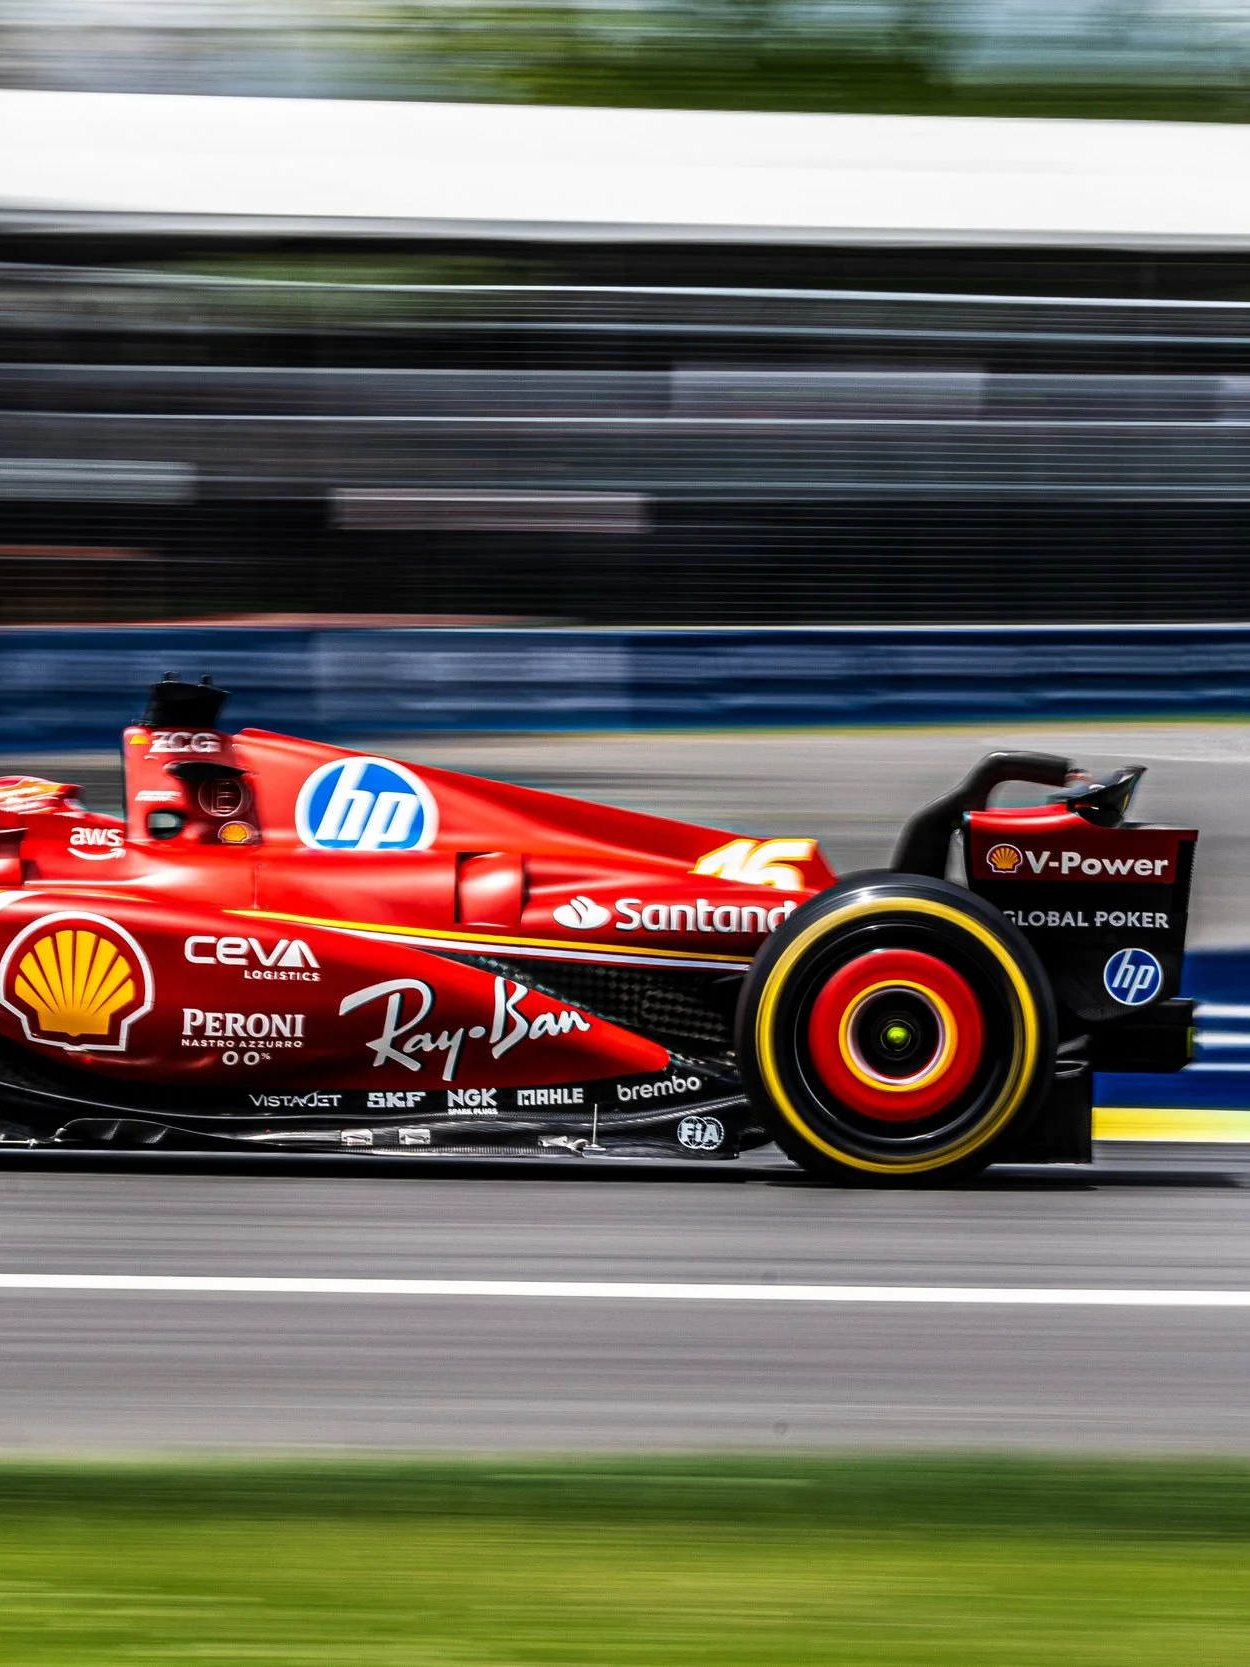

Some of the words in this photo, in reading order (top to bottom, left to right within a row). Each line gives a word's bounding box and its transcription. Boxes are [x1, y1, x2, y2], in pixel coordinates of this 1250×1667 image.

[312, 762, 421, 850] hp
[70, 827, 125, 847] aws
[1025, 851, 1169, 876] V-Power
[615, 898, 797, 932] Santand
[1094, 911, 1170, 928] POKER
[244, 970, 321, 982] LOGISTICS
[1111, 949, 1155, 1004] hp
[182, 1008, 306, 1038] PERONI
[181, 1039, 235, 1048] NASTRO
[239, 1040, 303, 1049] AZZURRO
[447, 1087, 498, 1107] NGK
[517, 1087, 584, 1106] MAHLE
[616, 1075, 702, 1101] brembo
[367, 1091, 426, 1108] SKF
